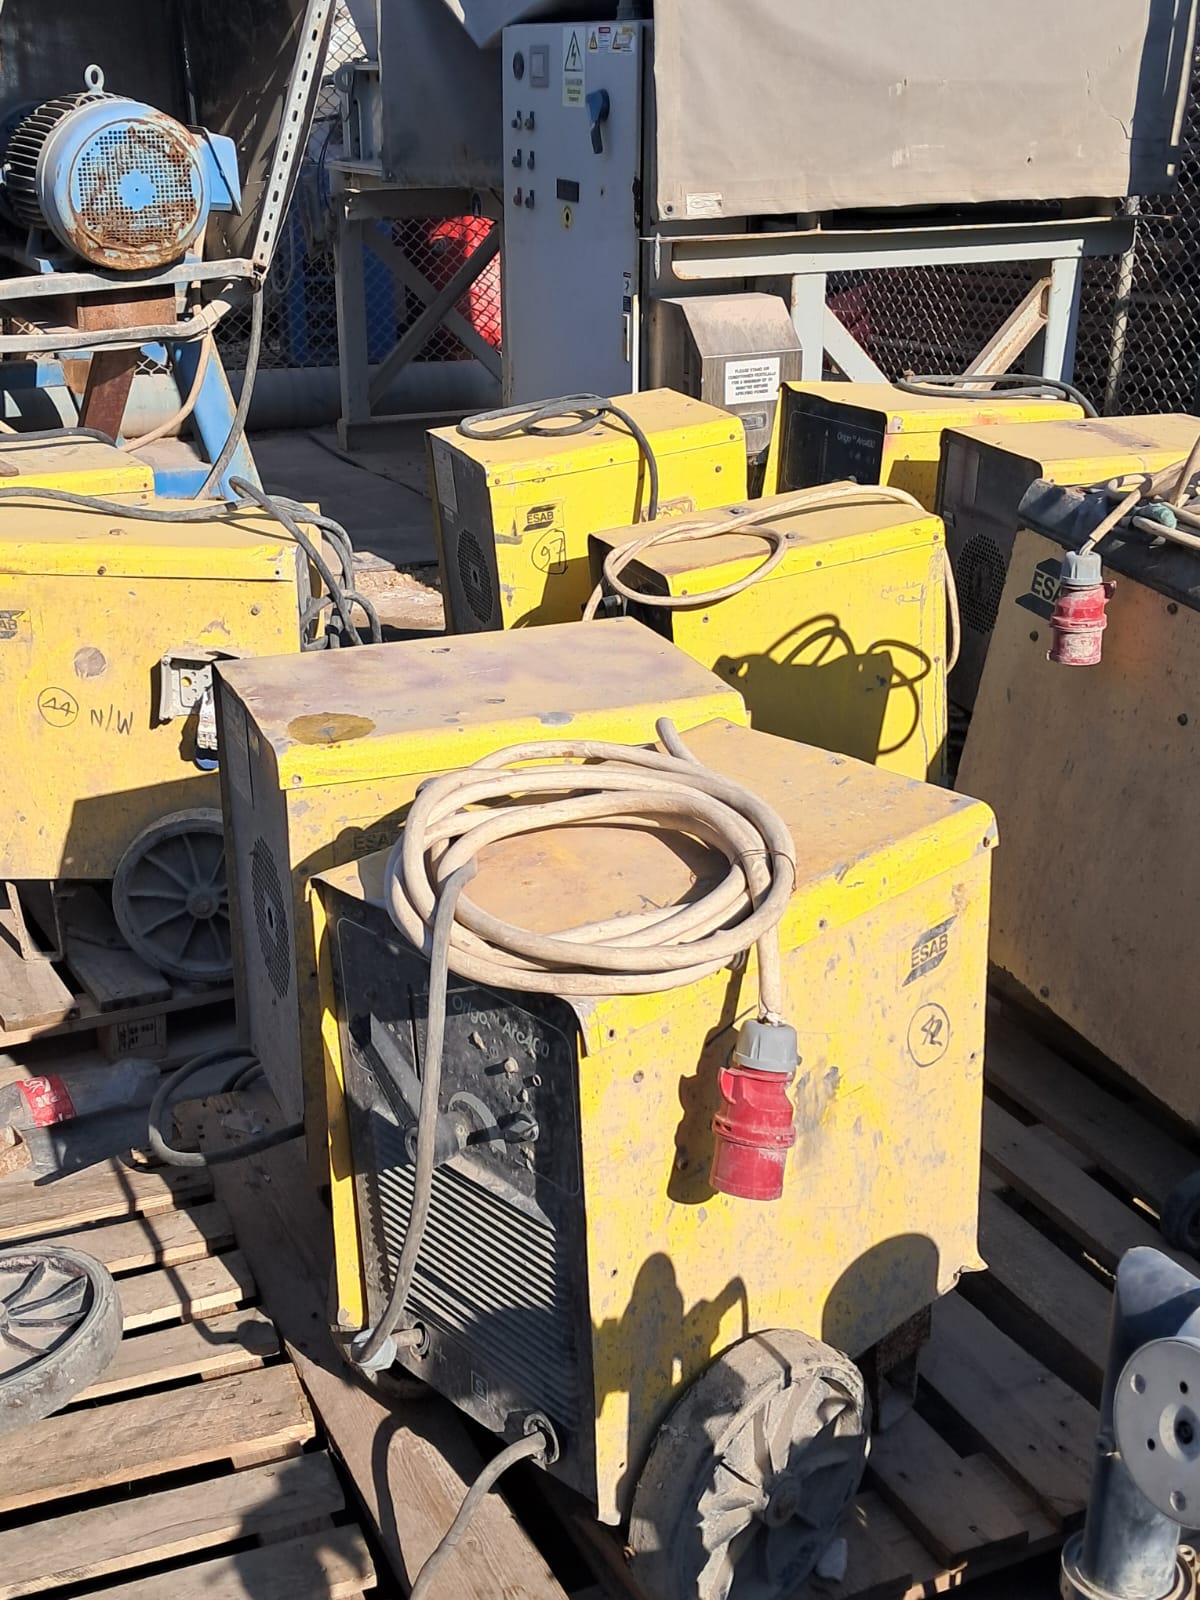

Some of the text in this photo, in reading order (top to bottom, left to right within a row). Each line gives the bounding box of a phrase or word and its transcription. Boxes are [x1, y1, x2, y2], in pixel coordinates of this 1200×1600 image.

[526, 511, 554, 524] ESAB
[41, 696, 133, 736] 44 N/W
[911, 933, 949, 968] ESAB
